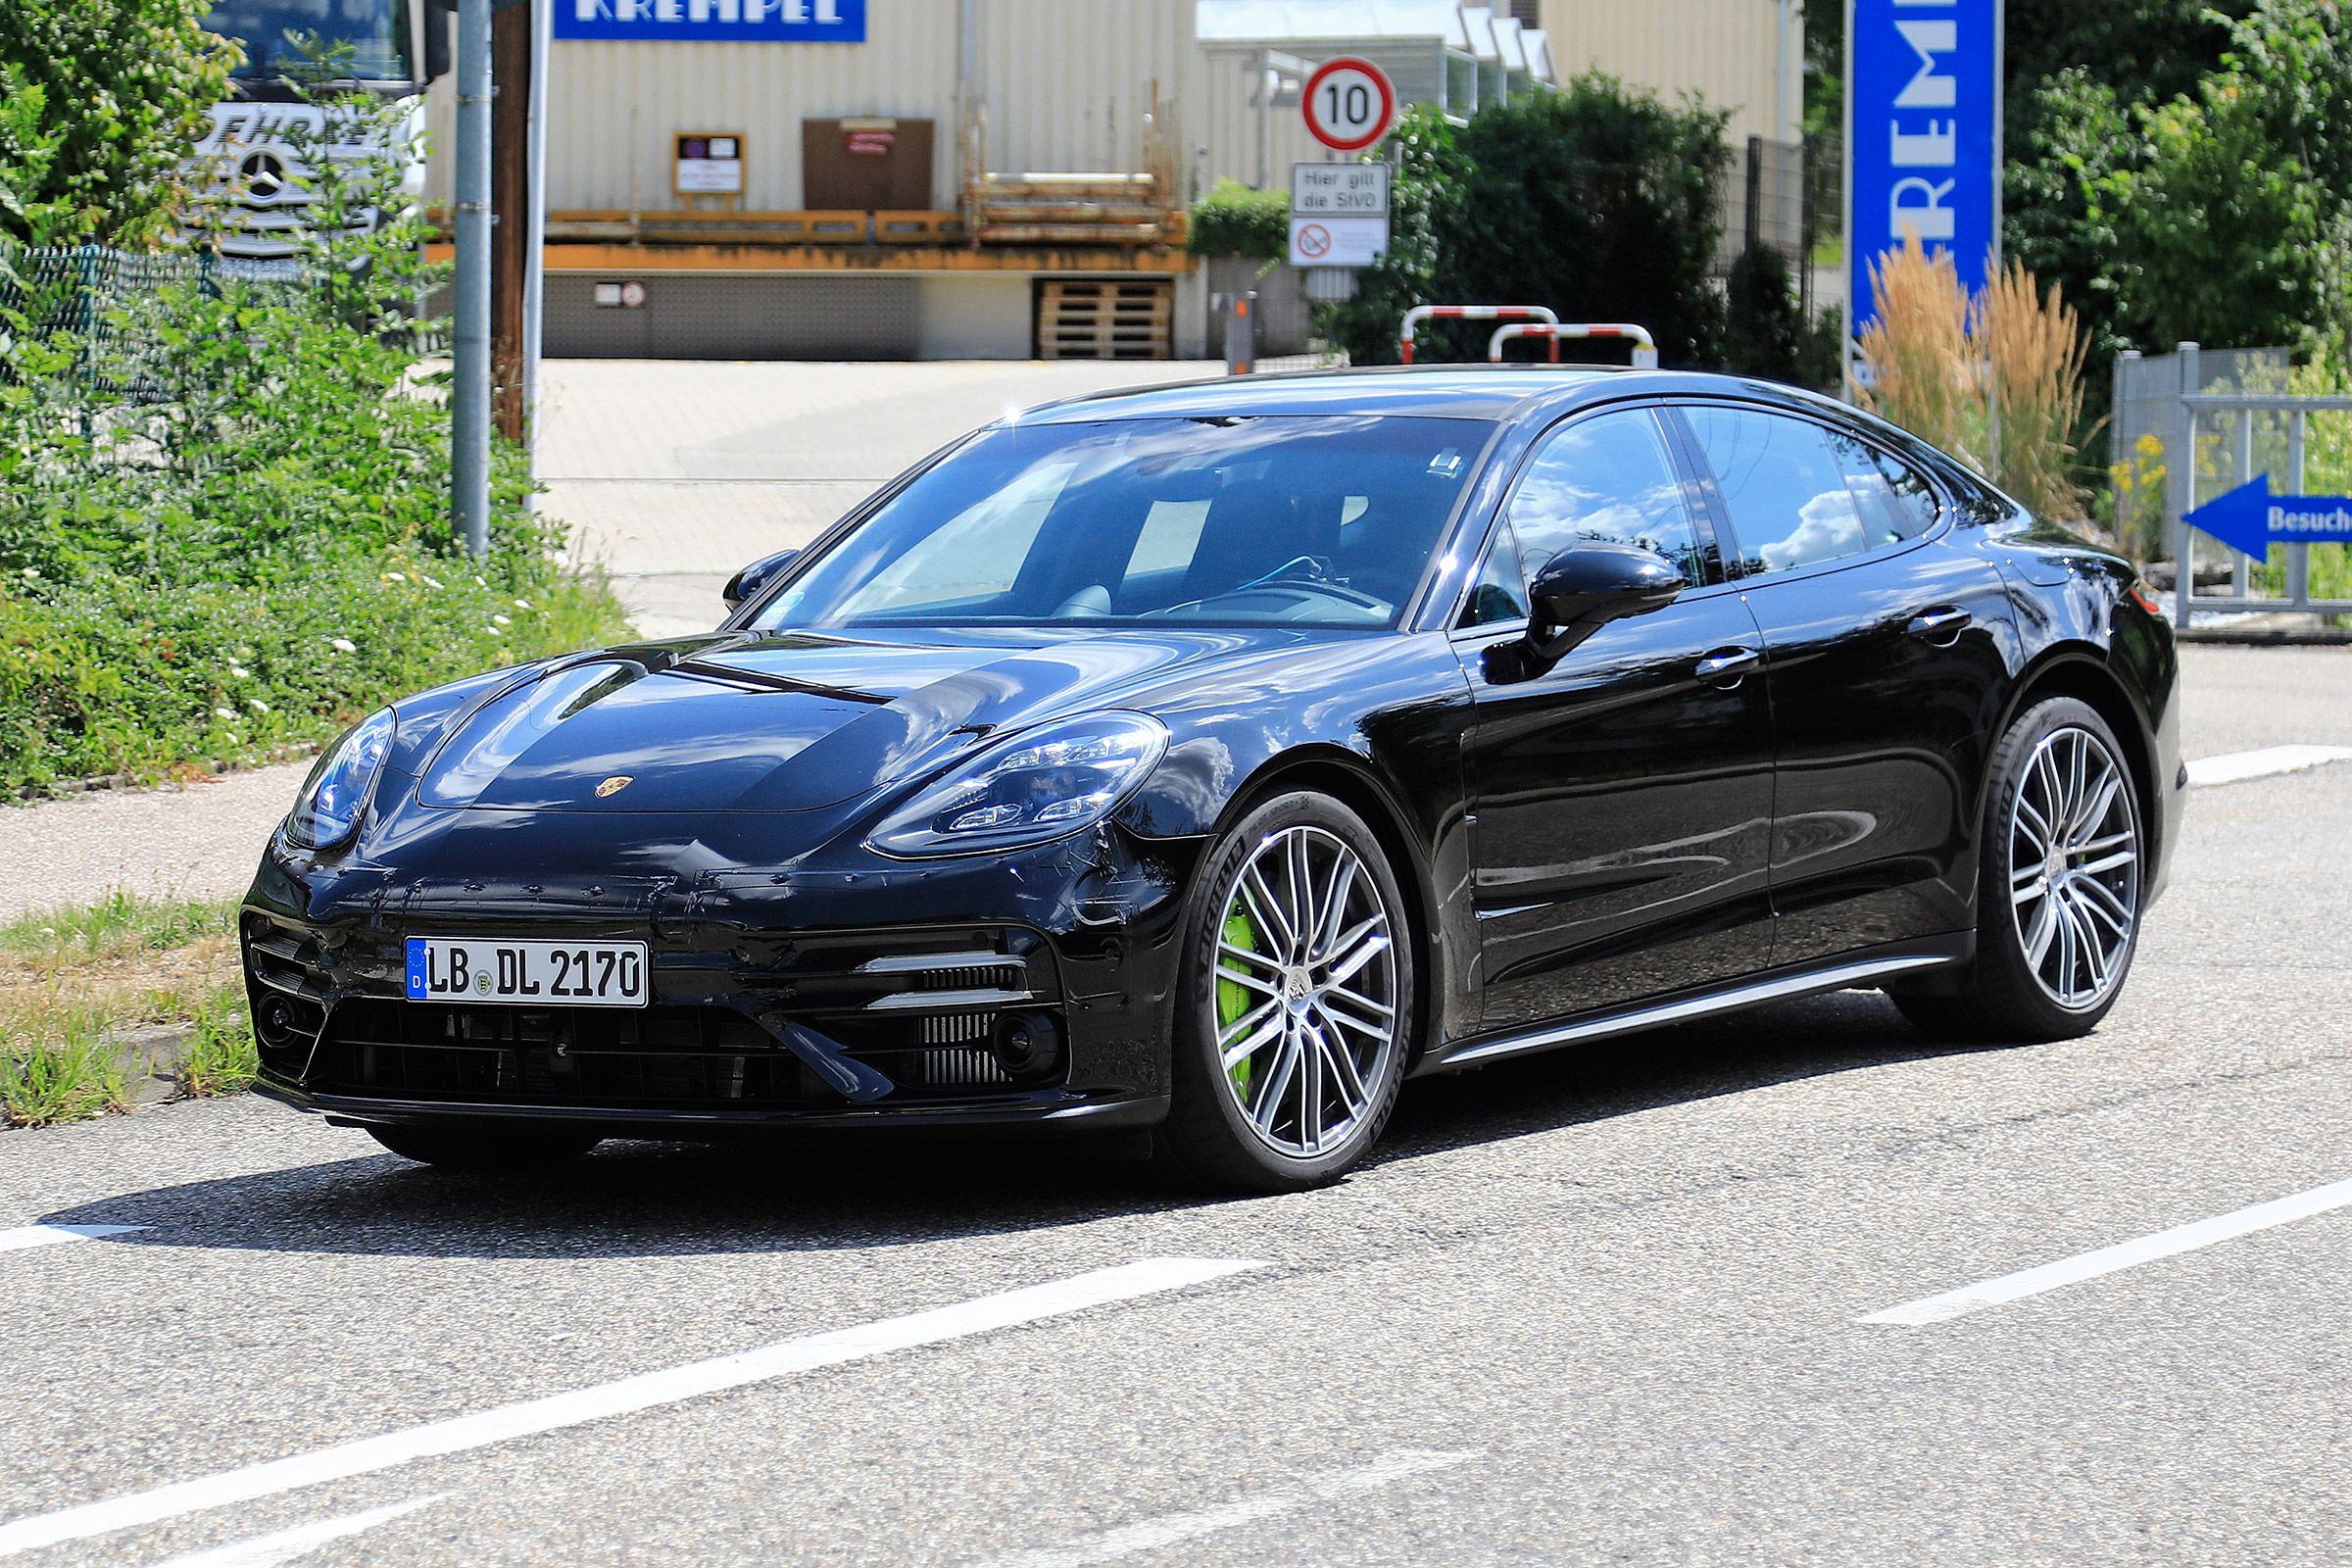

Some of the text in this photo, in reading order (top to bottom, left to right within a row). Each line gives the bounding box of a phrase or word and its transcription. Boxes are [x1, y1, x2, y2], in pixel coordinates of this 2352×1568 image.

[1326, 83, 1369, 124] 10
[1888, 0, 1957, 257] REM
[1305, 171, 1339, 185] Hier
[1304, 192, 1377, 207] die StVO
[2268, 506, 2352, 532] Besuch
[1199, 837, 1246, 965] MICHELIN
[413, 975, 420, 989] D
[428, 947, 640, 997] LB DL 2170
